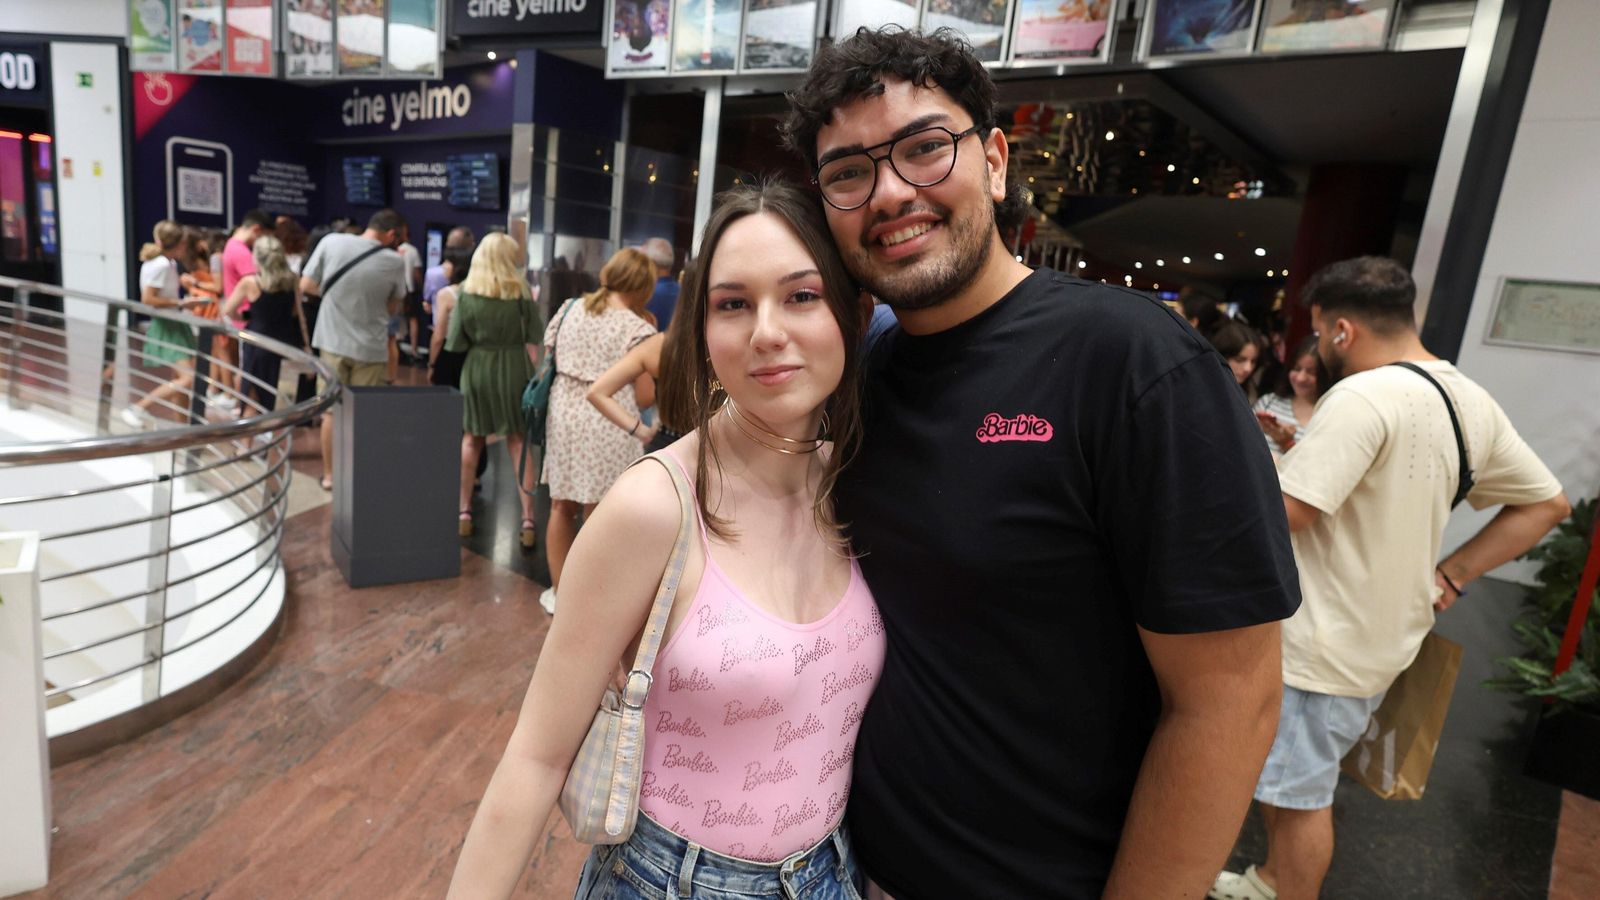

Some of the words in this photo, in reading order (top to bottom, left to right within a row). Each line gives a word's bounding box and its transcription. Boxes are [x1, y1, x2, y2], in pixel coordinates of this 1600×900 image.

[467, 0, 511, 18] cine
[342, 87, 386, 126] cine
[390, 80, 471, 131] yelmo
[977, 414, 1049, 439] Barbie
